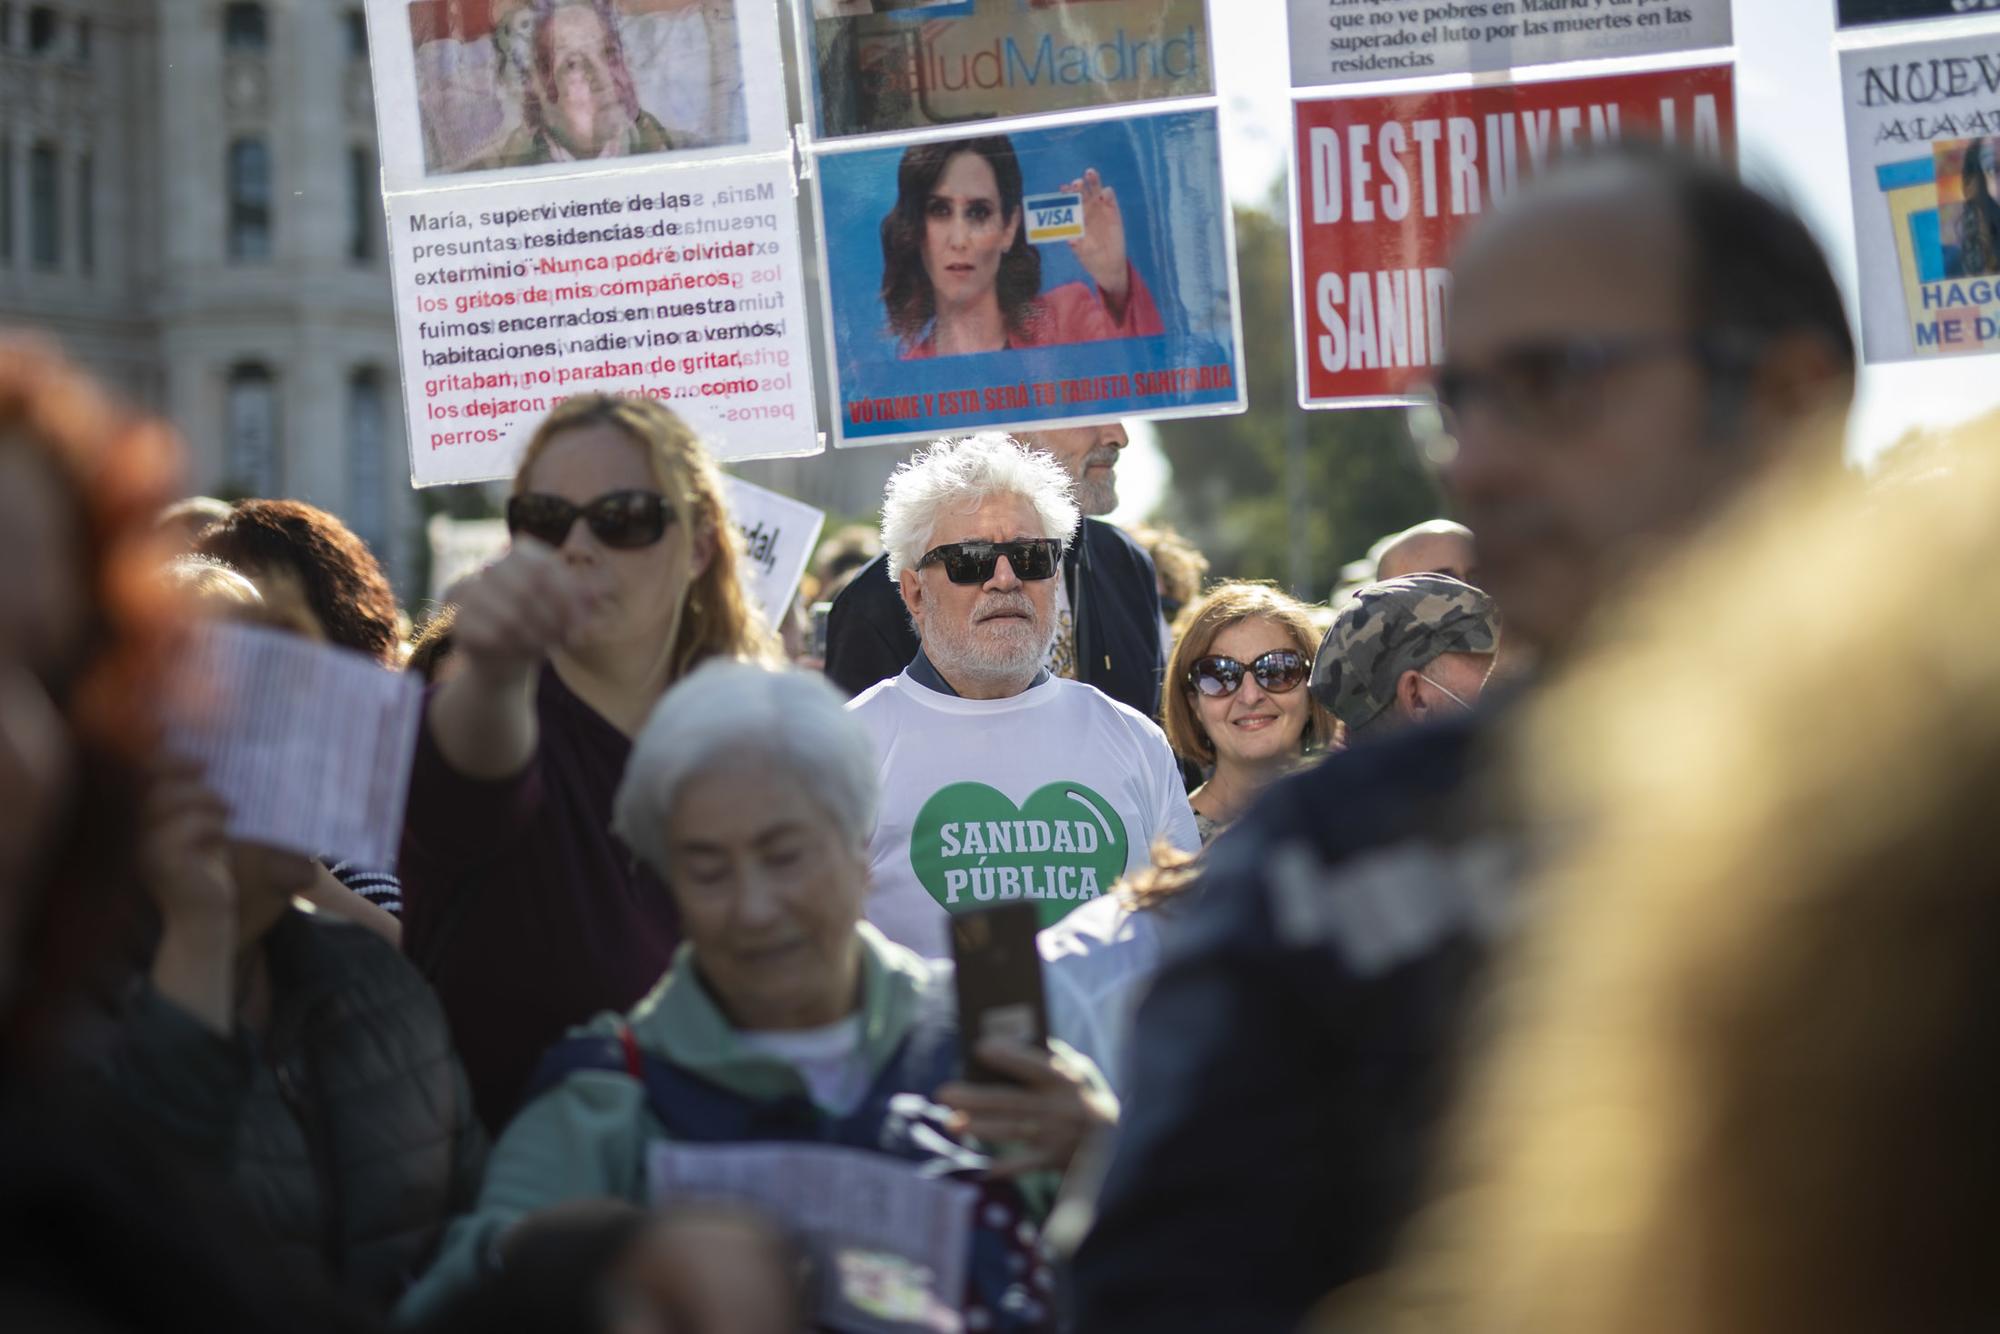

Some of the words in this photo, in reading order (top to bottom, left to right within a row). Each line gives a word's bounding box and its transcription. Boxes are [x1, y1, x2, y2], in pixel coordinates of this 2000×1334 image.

[1330, 13, 1364, 30] que
[1370, 12, 1393, 24] no
[1400, 9, 1418, 22] ve
[1425, 3, 1487, 24] pobres
[1492, 2, 1514, 15] en
[1330, 29, 1416, 51] superado
[1421, 27, 1437, 43] el
[1443, 26, 1480, 42] luto
[1485, 23, 1518, 42] por
[1524, 19, 1548, 36] las
[1554, 14, 1632, 33] muertes
[1637, 12, 1660, 26] en
[1666, 7, 1692, 24] las
[1331, 51, 1434, 72] residencias
[410, 211, 472, 232] María,
[480, 199, 622, 227] superviviente
[629, 195, 653, 211] de
[661, 192, 691, 209] las
[1037, 208, 1073, 227] VISA
[413, 237, 517, 262] presuntas
[524, 224, 645, 249] residencias
[653, 220, 677, 236] de
[415, 261, 525, 286] exterminio
[617, 246, 676, 271] podré
[683, 241, 755, 262] olvidar
[418, 296, 448, 312] los
[456, 289, 515, 313] gritos
[523, 286, 547, 303] de
[556, 283, 592, 300] mis
[601, 272, 737, 296] compañeros,
[1921, 280, 2000, 310] HAG
[420, 320, 491, 339] fuimos
[499, 308, 617, 333] encerrados
[624, 306, 649, 321] en
[657, 299, 736, 319] nuestra
[1916, 319, 1963, 346] ME
[423, 342, 562, 367] habitaciones,
[571, 334, 627, 353] nadie
[634, 330, 679, 347] vino
[686, 330, 699, 343] a
[705, 322, 782, 342] vernos,
[425, 370, 517, 397] gritaban,
[525, 370, 551, 384] no
[558, 361, 643, 385] paraban
[651, 357, 676, 373] de
[683, 352, 742, 374] gritar,
[849, 394, 920, 424] VÓTAME
[923, 393, 934, 417] Y
[938, 389, 980, 416] ESTA
[983, 380, 1029, 411] SERÁ
[1032, 382, 1056, 406] TU
[1059, 374, 1131, 403] TARJETA
[1133, 364, 1233, 397] SANITARIA
[428, 403, 458, 419] los
[466, 398, 545, 418] dejaron
[701, 379, 758, 396] como
[940, 820, 1099, 857] SANIDAD
[944, 855, 1102, 904] PÚBLICA
